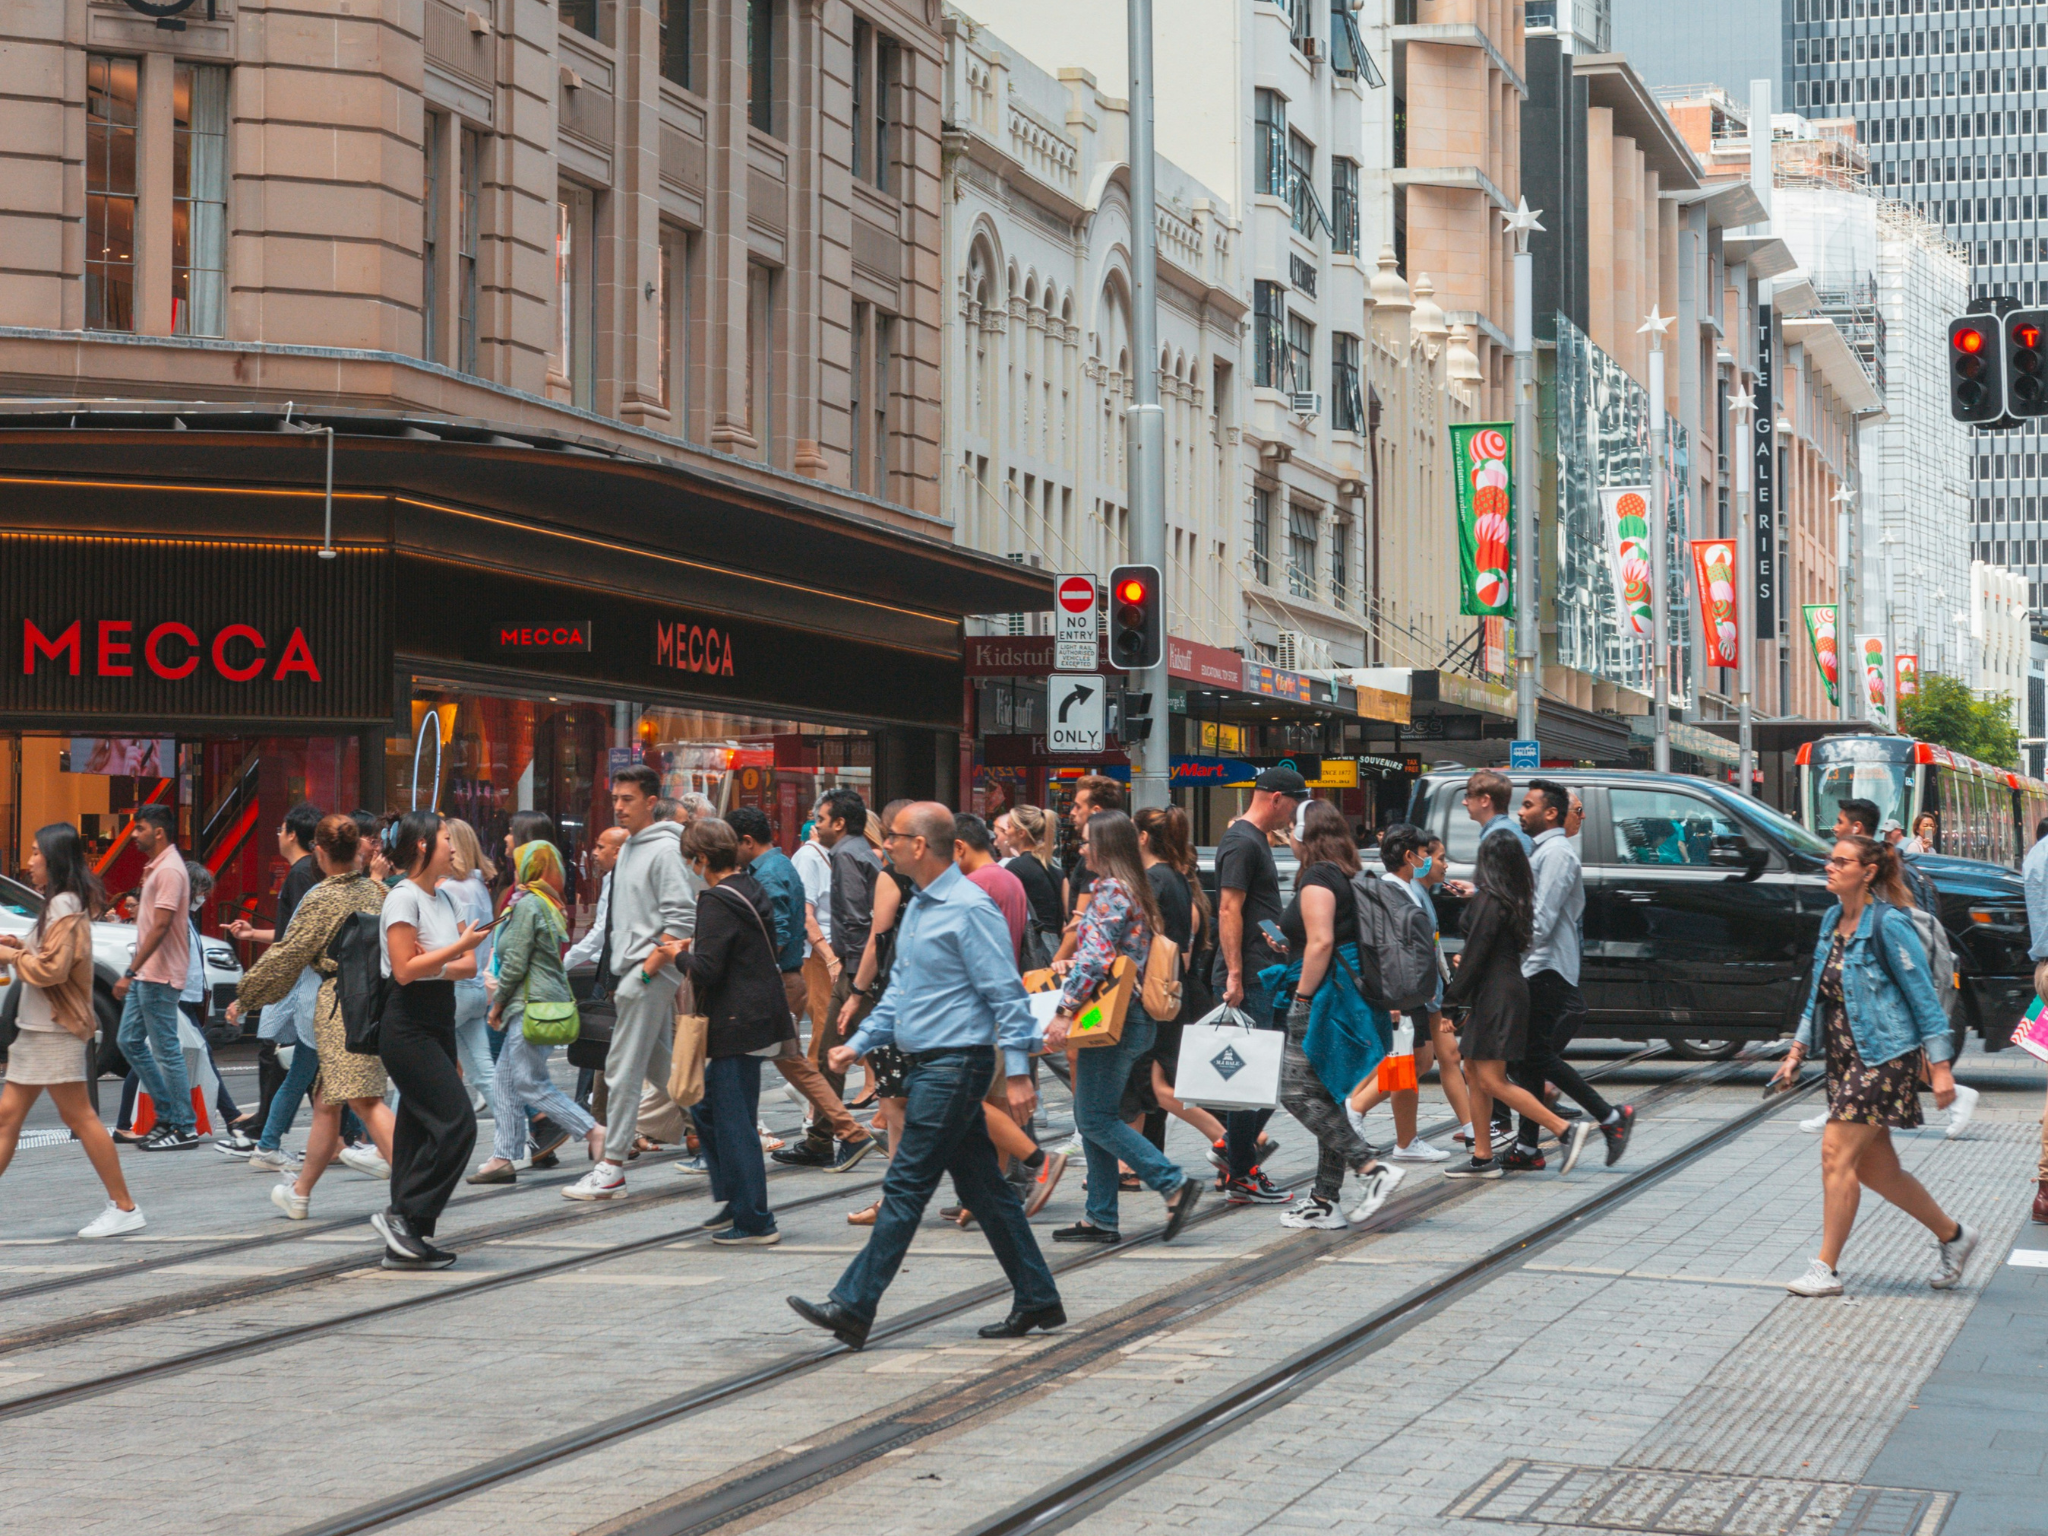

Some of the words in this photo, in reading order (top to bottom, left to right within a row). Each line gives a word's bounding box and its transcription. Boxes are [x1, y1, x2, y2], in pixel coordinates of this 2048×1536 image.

[1758, 326, 1769, 387] THE
[1456, 456, 1465, 494] christmas
[1755, 418, 1771, 599] GALERIES
[1059, 631, 1094, 640] ENTRY
[1067, 616, 1087, 628] NO
[23, 617, 322, 682] MECCA
[501, 628, 583, 646] MECCA
[657, 618, 735, 677] MECCA
[975, 644, 1056, 667] Kidstuf
[1169, 643, 1192, 672] Kidstuff
[996, 688, 1034, 729] Kidtuff
[1053, 730, 1099, 744] ONLY
[1360, 755, 1403, 771] SOUVENIRS
